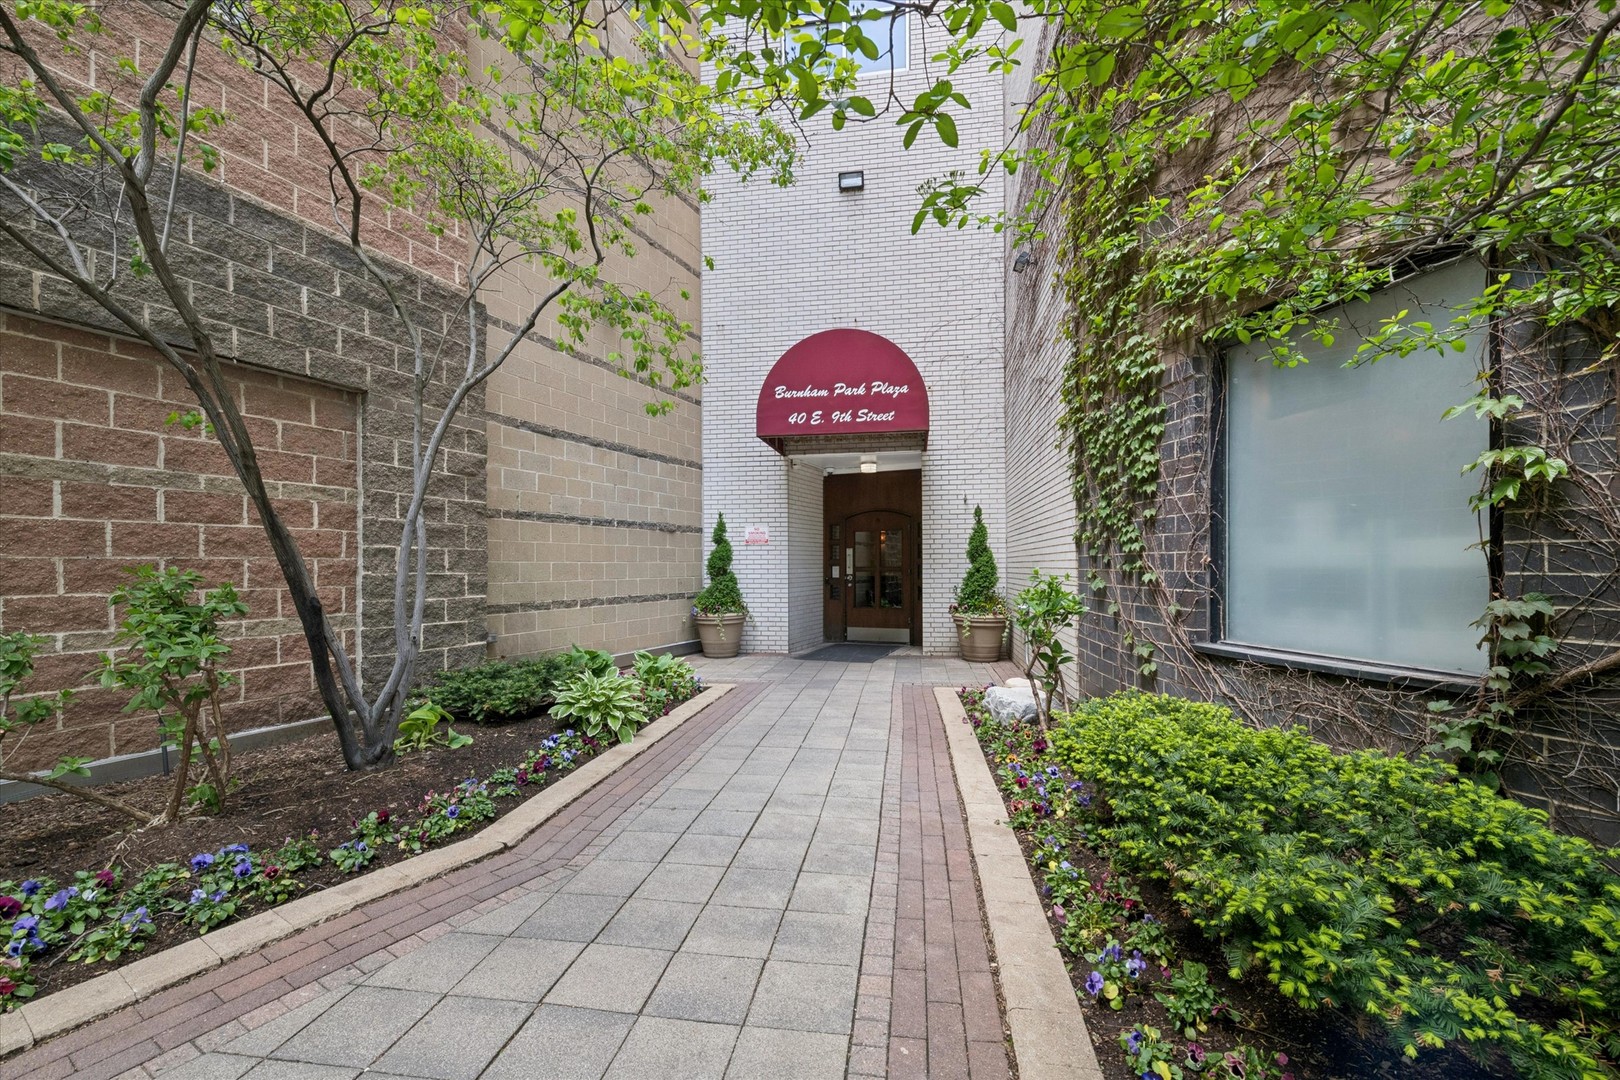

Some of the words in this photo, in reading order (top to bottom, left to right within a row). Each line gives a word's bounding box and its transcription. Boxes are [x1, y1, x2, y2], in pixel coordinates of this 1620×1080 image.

[774, 384, 830, 399] Burnham
[833, 382, 867, 398] Park
[870, 380, 910, 399] Plaza
[787, 412, 807, 425] 40
[809, 410, 825, 426] E.
[831, 409, 853, 424] 9th
[855, 408, 896, 423] Street
